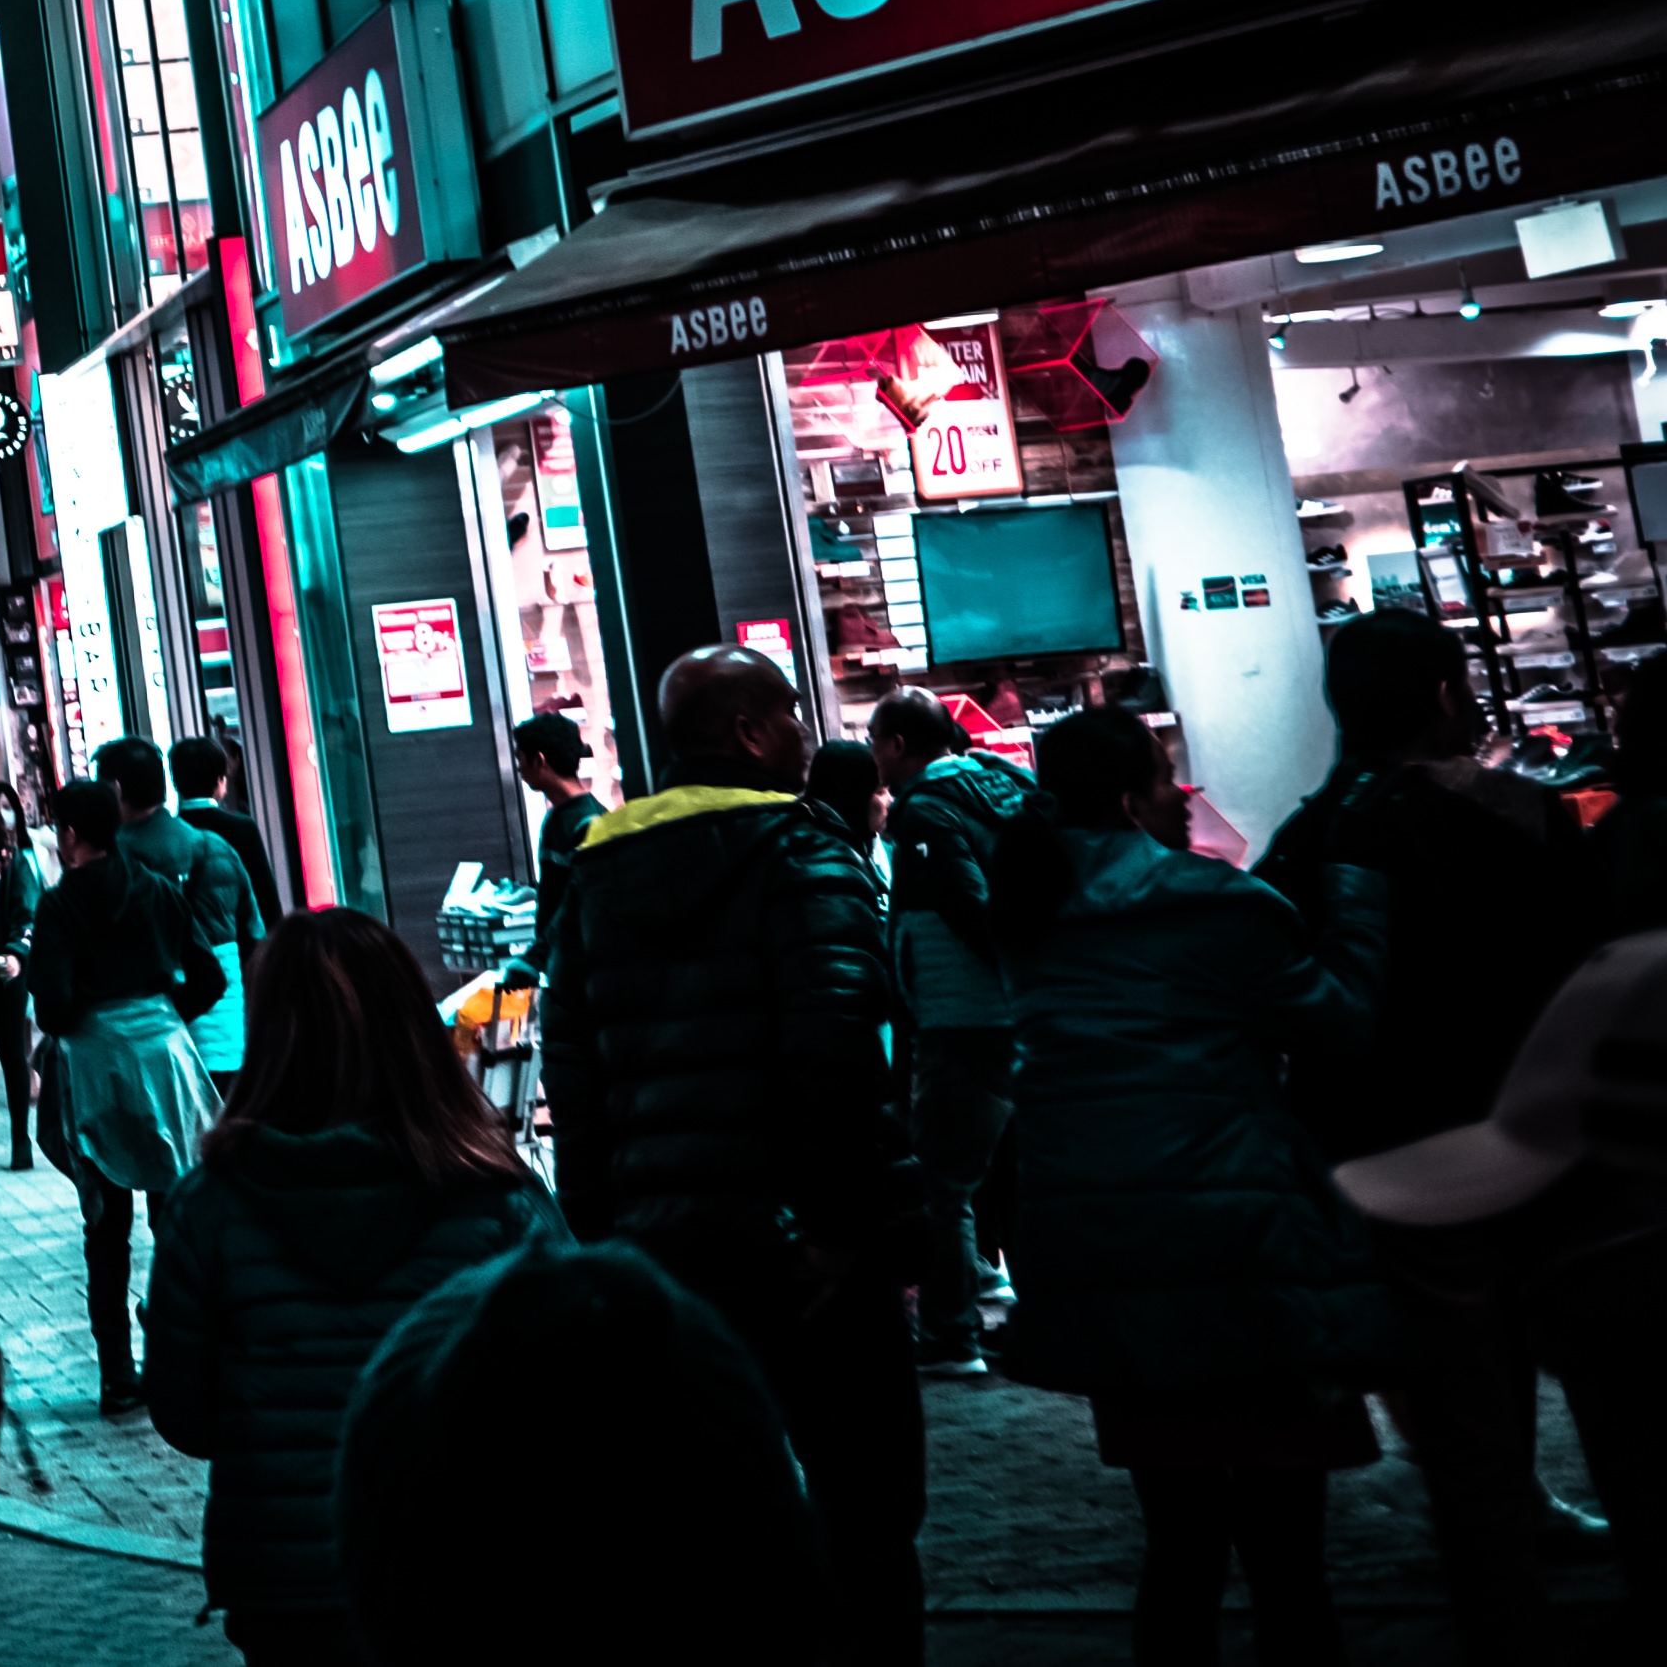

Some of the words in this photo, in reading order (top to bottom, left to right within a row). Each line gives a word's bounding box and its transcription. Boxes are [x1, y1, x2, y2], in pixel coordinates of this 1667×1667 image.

[927, 425, 967, 476] 20
[970, 458, 1003, 474] OFF
[1239, 573, 1267, 586] VISA
